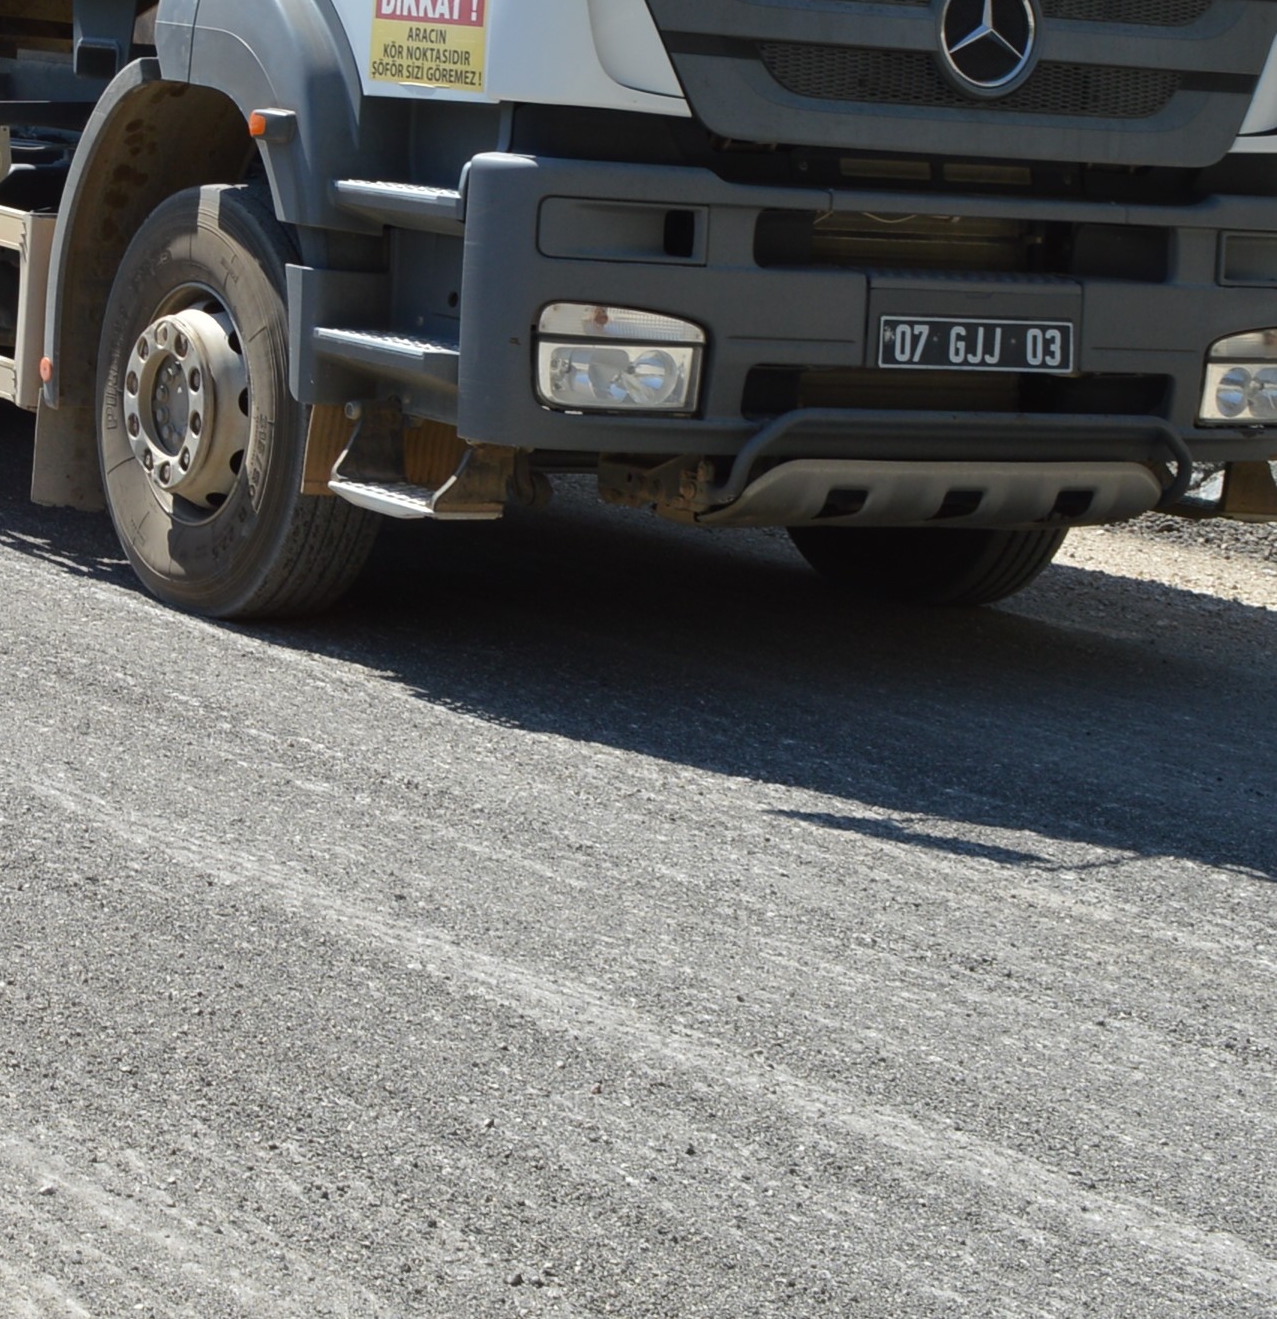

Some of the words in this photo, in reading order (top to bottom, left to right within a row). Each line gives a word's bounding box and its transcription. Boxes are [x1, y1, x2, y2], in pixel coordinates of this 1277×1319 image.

[407, 27, 446, 44] ARACIN
[383, 41, 404, 60] KÖR
[406, 45, 471, 66] NOKTASIDIR
[372, 59, 404, 79] ŞÖFÖR
[406, 63, 425, 80] SİZİ
[427, 65, 476, 86] GÖREMEZ
[894, 324, 929, 362] 07
[949, 326, 1002, 364] GJJ
[1026, 328, 1062, 366] 03
